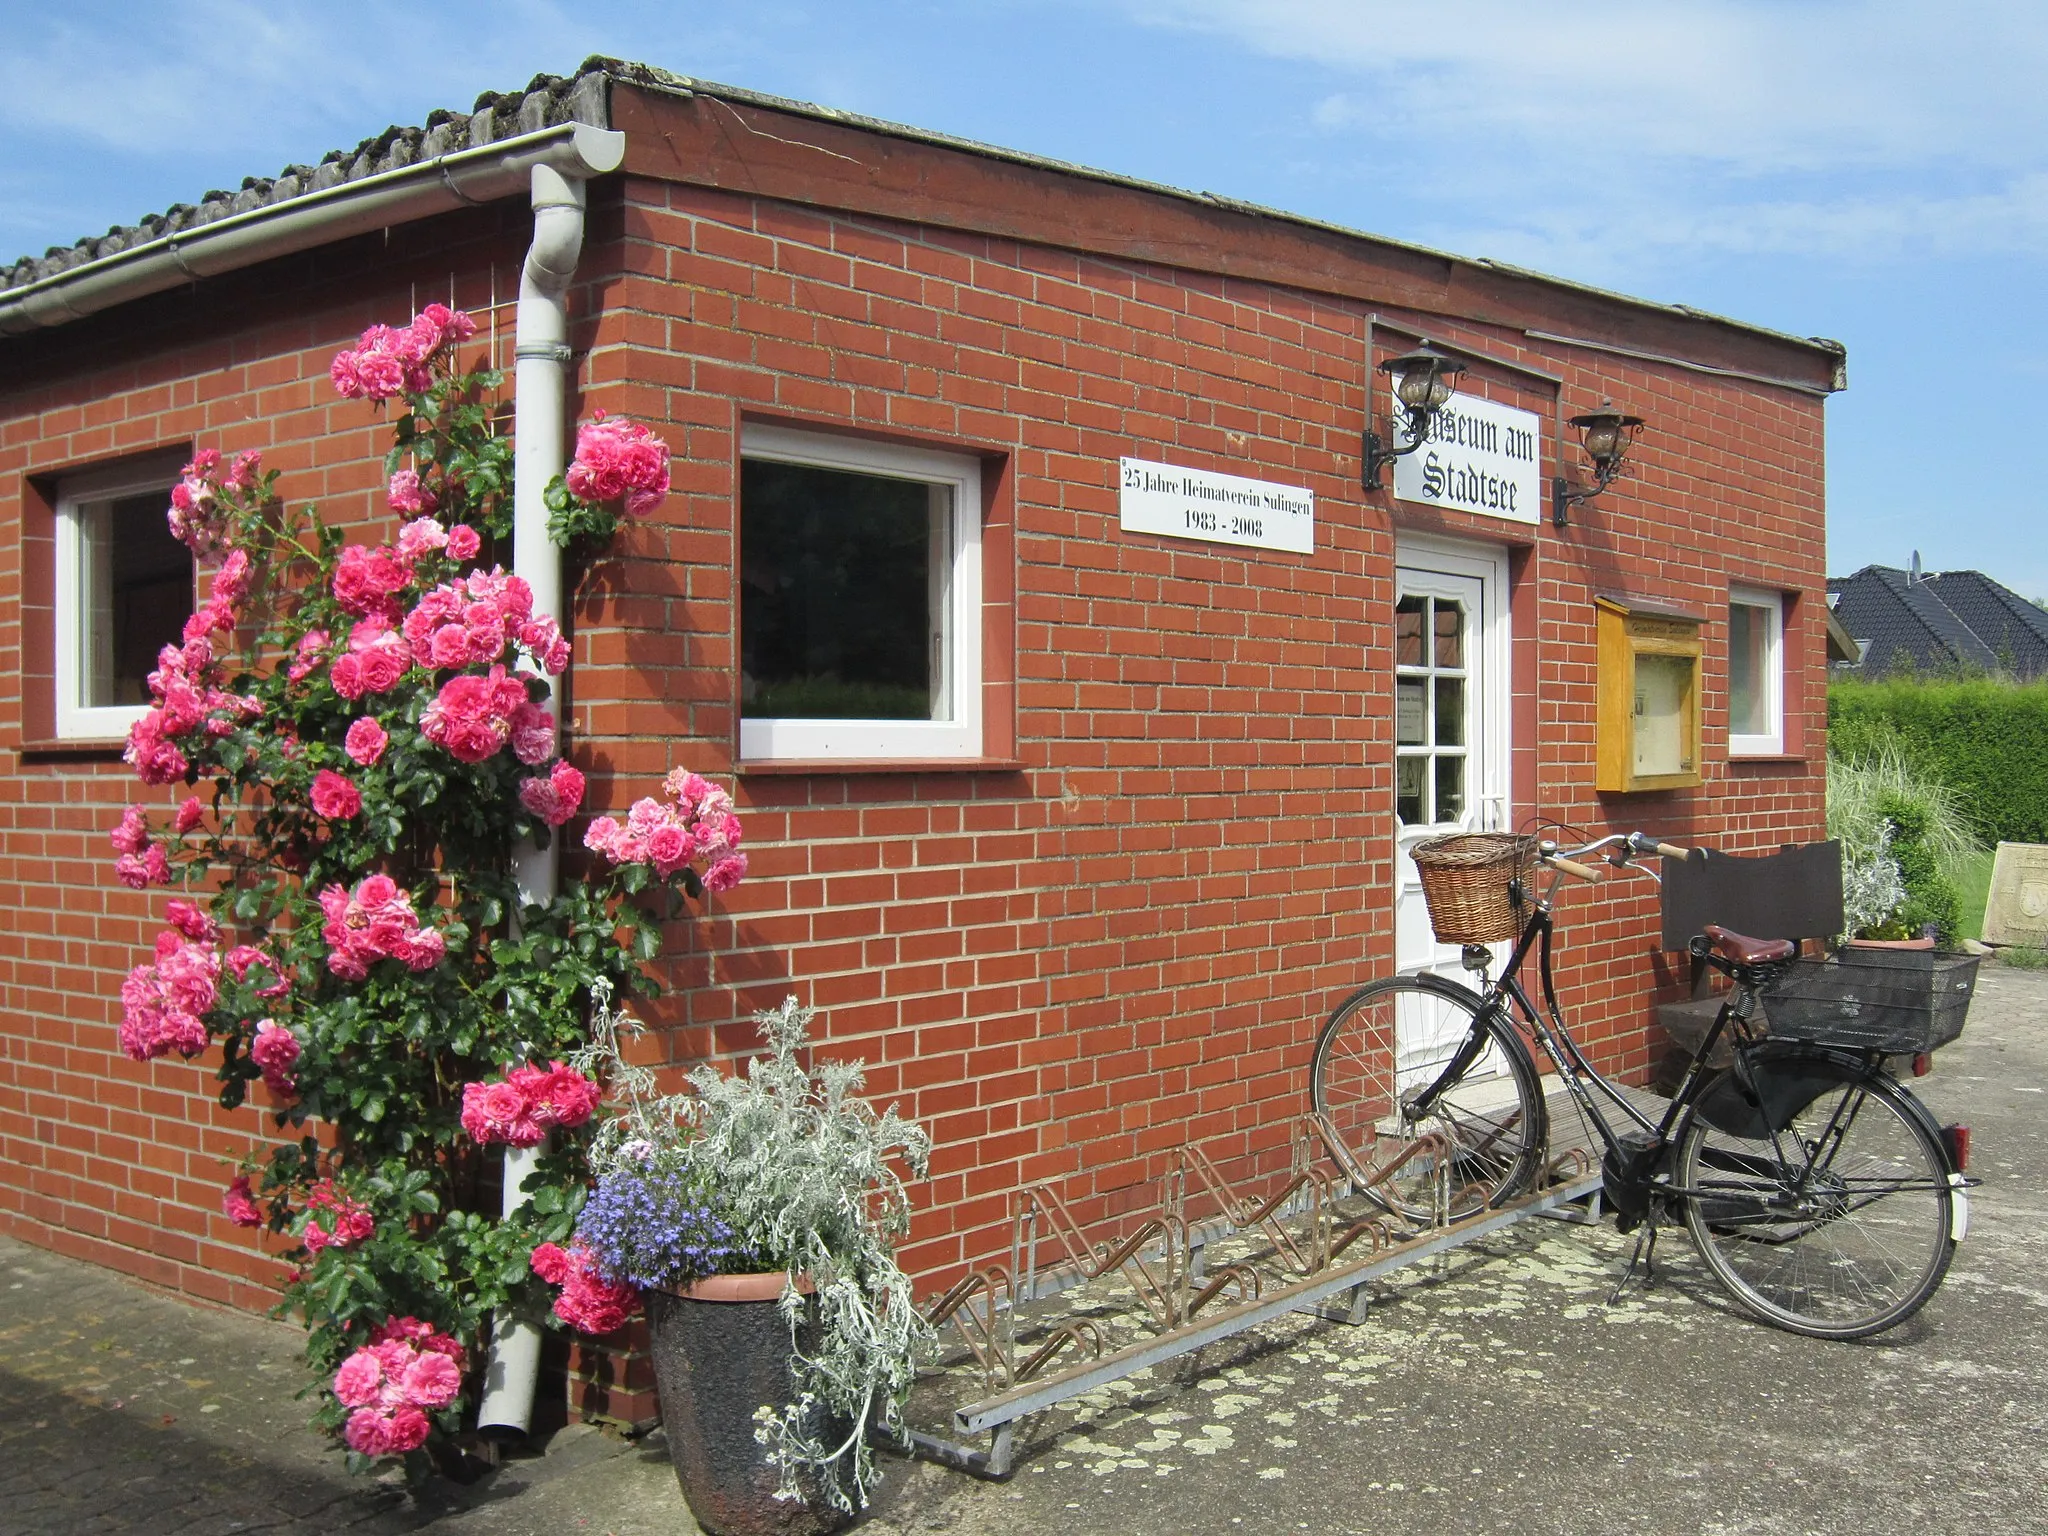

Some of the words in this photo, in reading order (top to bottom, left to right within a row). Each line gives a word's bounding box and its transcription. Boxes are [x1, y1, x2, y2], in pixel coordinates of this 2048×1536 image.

[1505, 426, 1534, 463] am
[1124, 467, 1141, 489] 25
[1143, 471, 1179, 496] Jahre
[1182, 477, 1261, 508] Heimatverein
[1263, 491, 1311, 519] Sulingen
[1422, 450, 1518, 512] Stadtsee
[1184, 509, 1216, 532] 1983
[1231, 516, 1263, 538] 2008
